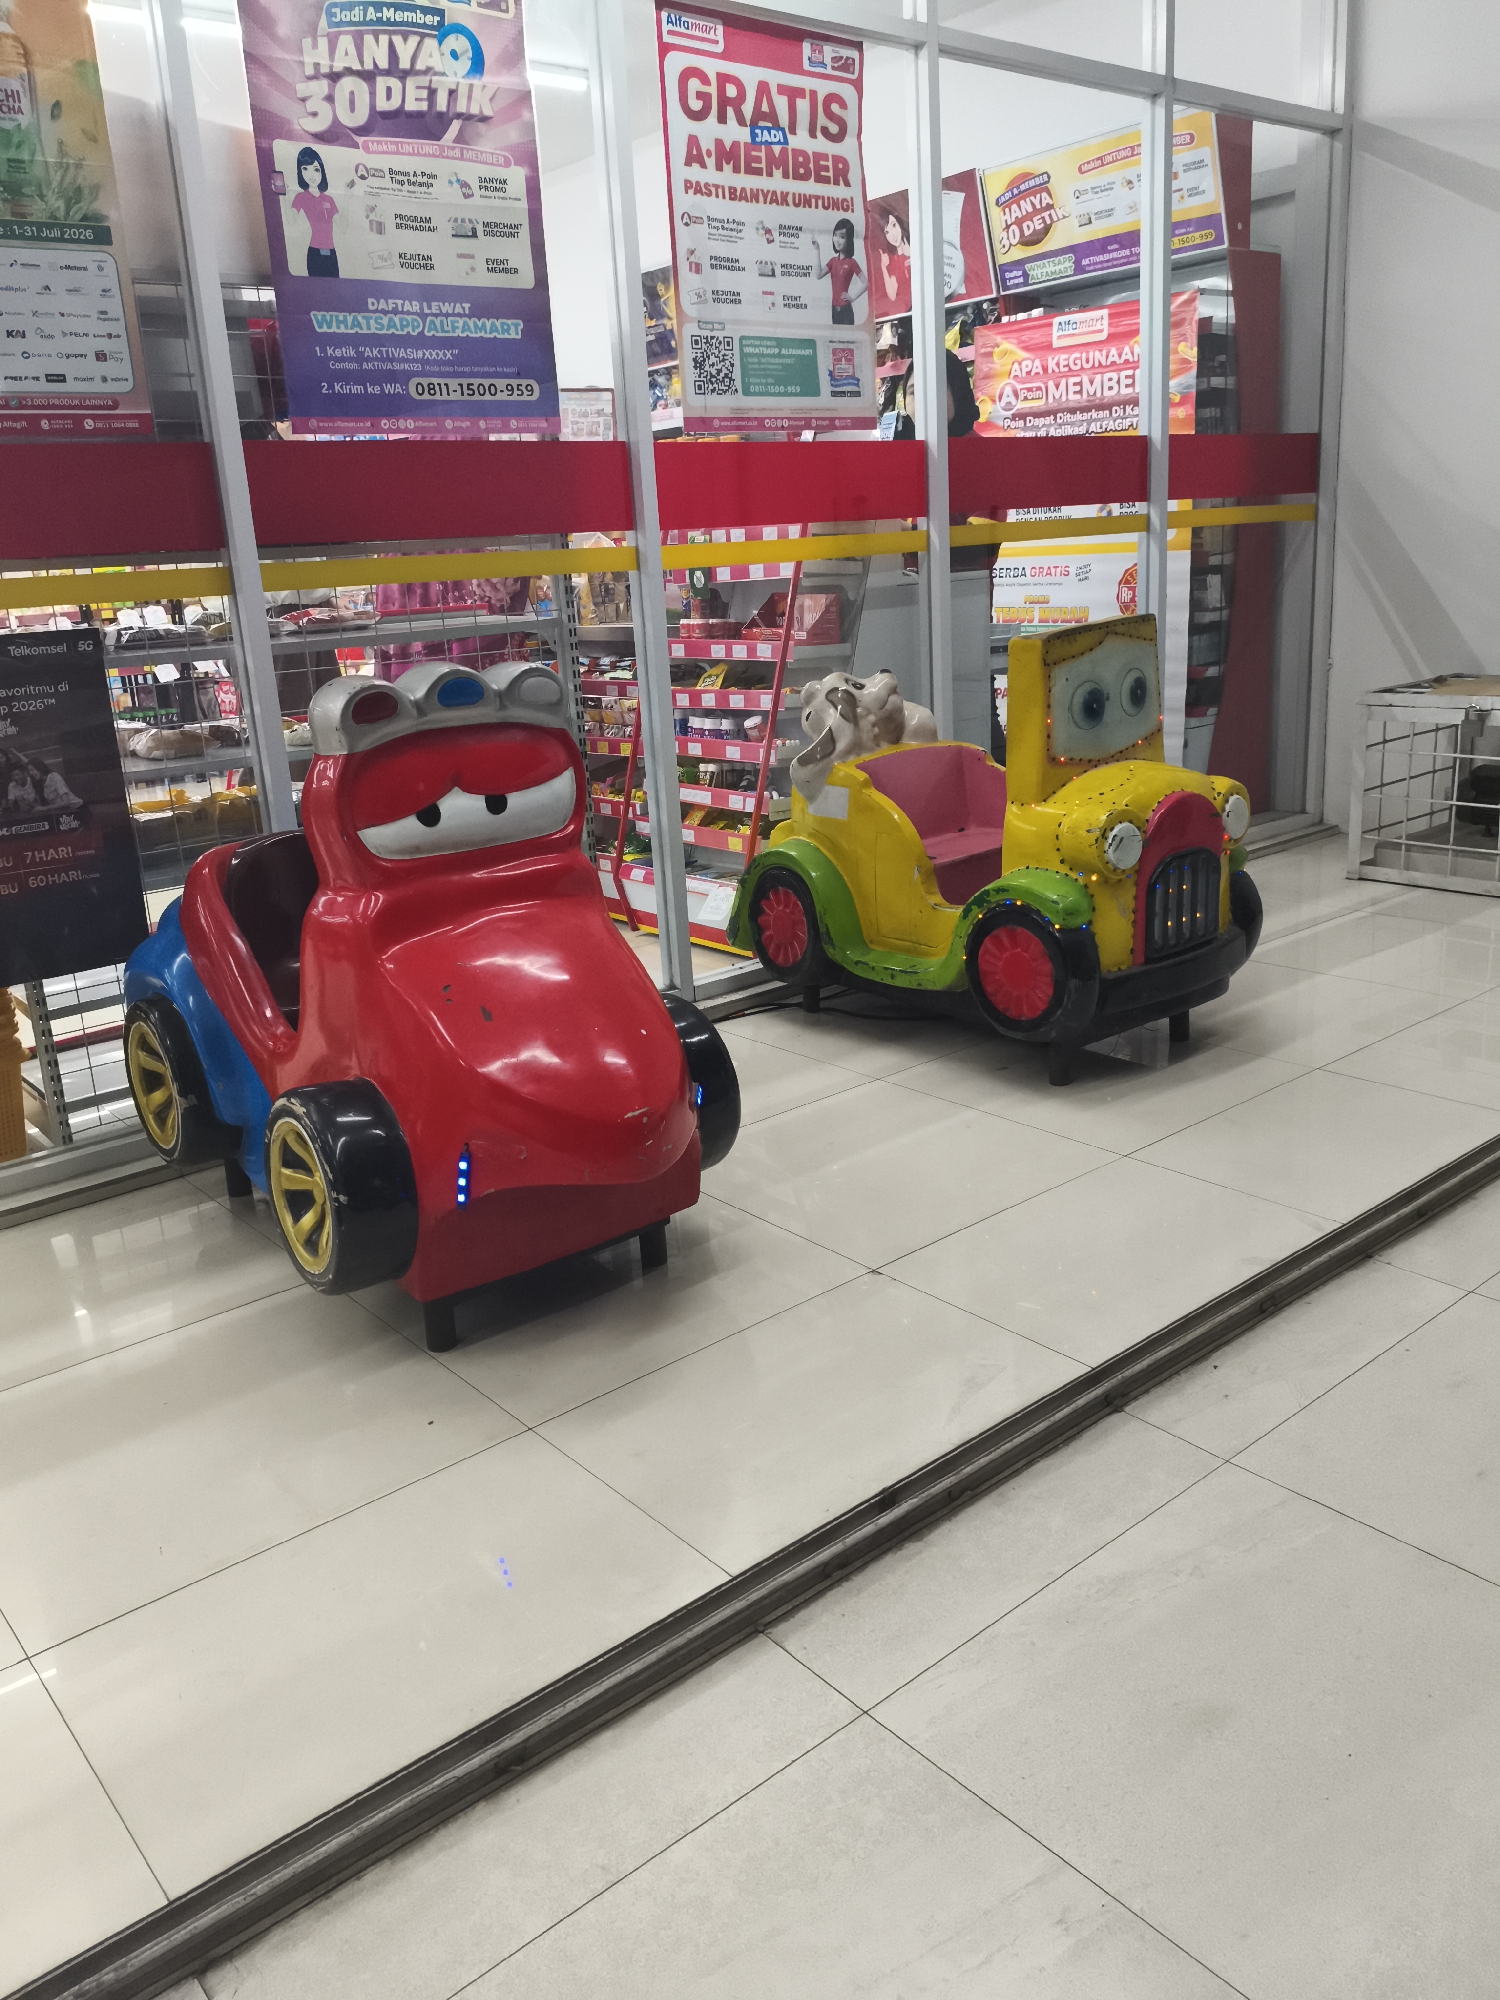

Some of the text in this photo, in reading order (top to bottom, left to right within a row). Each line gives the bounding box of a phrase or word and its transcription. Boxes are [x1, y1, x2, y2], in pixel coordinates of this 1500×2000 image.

[331, 5, 441, 26] Jadi A-Member
[666, 13, 719, 37] Alfamart
[301, 34, 446, 76] HANYA
[296, 75, 501, 135] 30 DETIK
[677, 66, 849, 144] GRATIS
[754, 129, 785, 143] JADI
[368, 142, 505, 166] Makin UNTUNG Jadi MEMBER
[1081, 157, 1102, 172] Makin
[1102, 148, 1132, 166] UNTUNG
[388, 168, 438, 181] Bonus A-Poin
[390, 177, 434, 189] Tiap Belanja
[477, 177, 509, 186] BANYAK
[478, 185, 507, 194] PROMO
[998, 174, 1048, 205] JADI A-MEMBER
[684, 179, 855, 214] PASTI BANYAK UNTUNG!
[1000, 192, 1054, 228] HANYA
[394, 213, 432, 224] PROGRAM
[707, 215, 746, 227] Bonus A-Poin
[395, 222, 439, 233] BERHADIAH
[482, 221, 523, 231] MERCHANT
[707, 223, 720, 232] Tiap
[778, 223, 803, 232] BANYAK
[998, 205, 1071, 255] 30 DETIK
[13, 225, 94, 240] 1-31 Juli 2026
[483, 230, 521, 239] DISCOUNT
[778, 231, 800, 239] PROMO
[398, 252, 433, 262] KEJUTAN
[485, 258, 510, 267] EVENT
[709, 255, 740, 265] PROGRAM
[399, 261, 436, 271] VOUCHER
[486, 266, 519, 275] MEMBER
[710, 263, 746, 272] BERHADIAH
[780, 263, 813, 272] MERCHANT
[1005, 270, 1023, 278] Daftar
[1025, 255, 1074, 273] WHATSAPP
[780, 270, 811, 278] DISCOUNT
[1006, 265, 1074, 286] Lewat ALFAMART
[711, 289, 741, 298] KEJUTAN
[782, 294, 801, 302] EVENT
[367, 298, 471, 315] DAFTAR LEWAT
[712, 297, 743, 305] VOUCHER
[783, 302, 808, 310] MEMBER
[311, 312, 523, 339] WHATSAPP ALFAMART
[1056, 315, 1105, 333] Alfamart
[6, 329, 26, 339] KAI
[315, 346, 324, 357] 1.
[326, 346, 357, 358] Ketik
[742, 347, 779, 355] WHATSAPP
[329, 361, 361, 371] Contoh:
[455, 366, 471, 374] harap
[1009, 357, 1044, 379] APA
[321, 382, 535, 398] 2. Kirim ke WA: 0811-1500-959
[749, 385, 801, 394] 0811-1500-959
[1020, 387, 1043, 400] Poin
[1003, 418, 1025, 430] Poin
[1026, 414, 1055, 427] Dapat
[1056, 409, 1110, 424] Ditukarkan
[1111, 405, 1124, 417] Di
[1048, 423, 1087, 437] Aplikasi
[1088, 417, 1140, 434] ALFAGIFT
[1015, 507, 1031, 516] BISA
[992, 567, 1027, 579] SERBA
[1023, 594, 1051, 605] PROMO
[1121, 587, 1133, 603] Rp
[994, 606, 1090, 624] TEBUS MURAH
[7, 640, 94, 657] Telkomsel 5G
[57, 681, 69, 692] di
[14, 822, 47, 834] GEMBIRA
[23, 851, 33, 864] 7
[34, 846, 73, 862] HARI
[28, 875, 47, 888] 60
[47, 869, 82, 885] HARI
